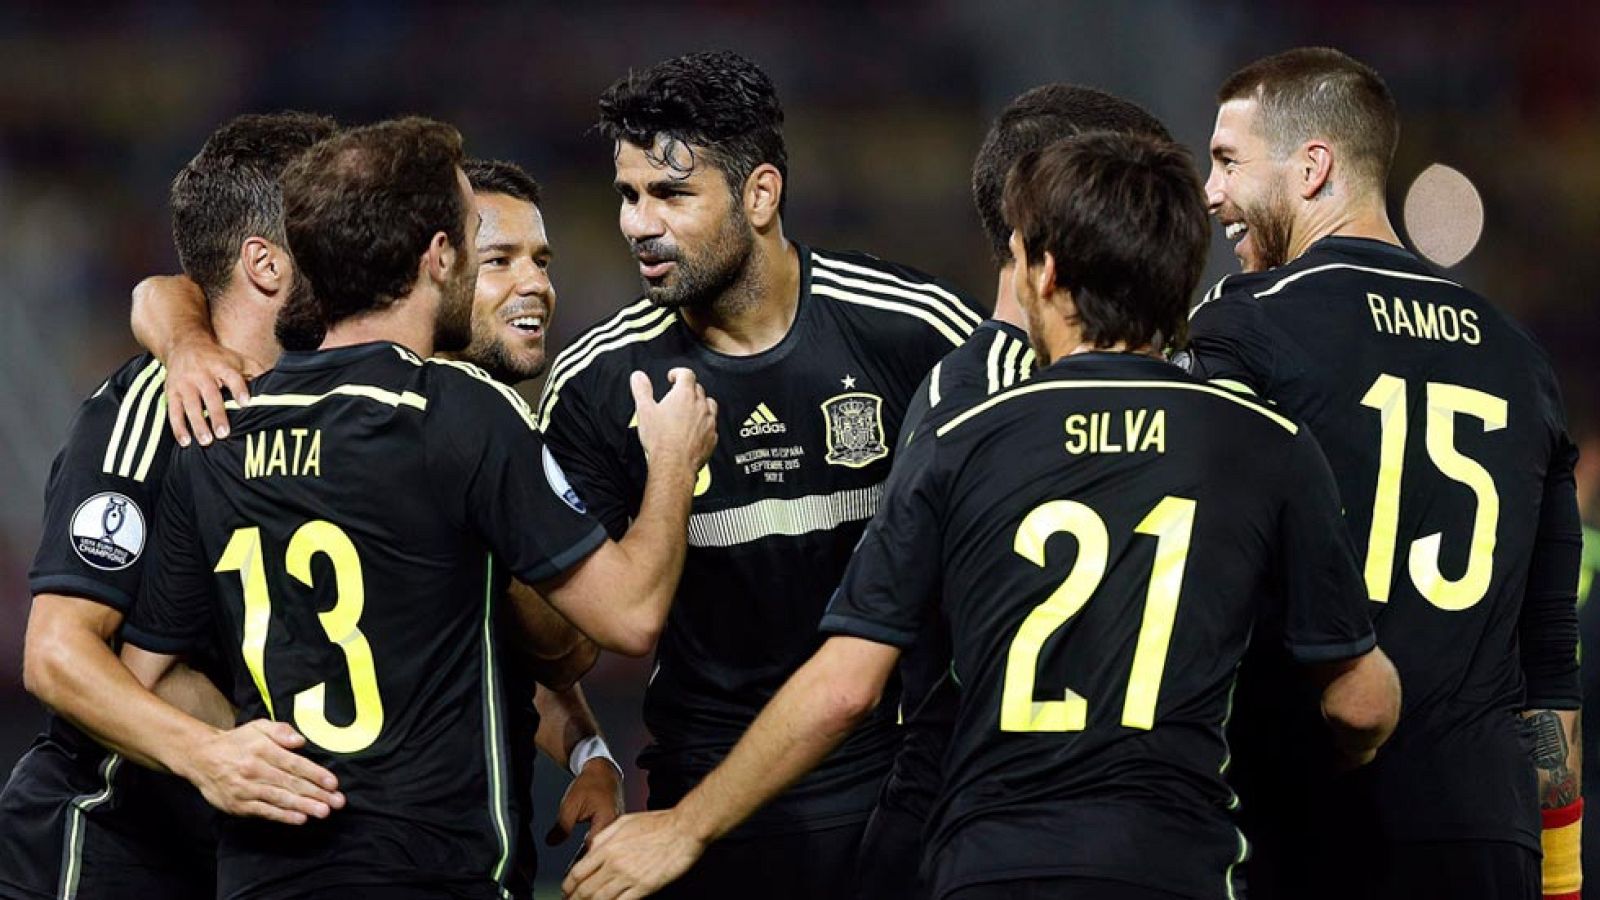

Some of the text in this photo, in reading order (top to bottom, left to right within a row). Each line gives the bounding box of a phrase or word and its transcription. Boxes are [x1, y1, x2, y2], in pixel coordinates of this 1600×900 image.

[1367, 293, 1481, 345] RAMOS
[245, 429, 321, 479] MATA
[740, 423, 787, 438] adidas
[1065, 410, 1166, 455] SILVA
[1361, 373, 1508, 612] 15
[214, 520, 385, 754] 13
[1000, 496, 1198, 733] 21
